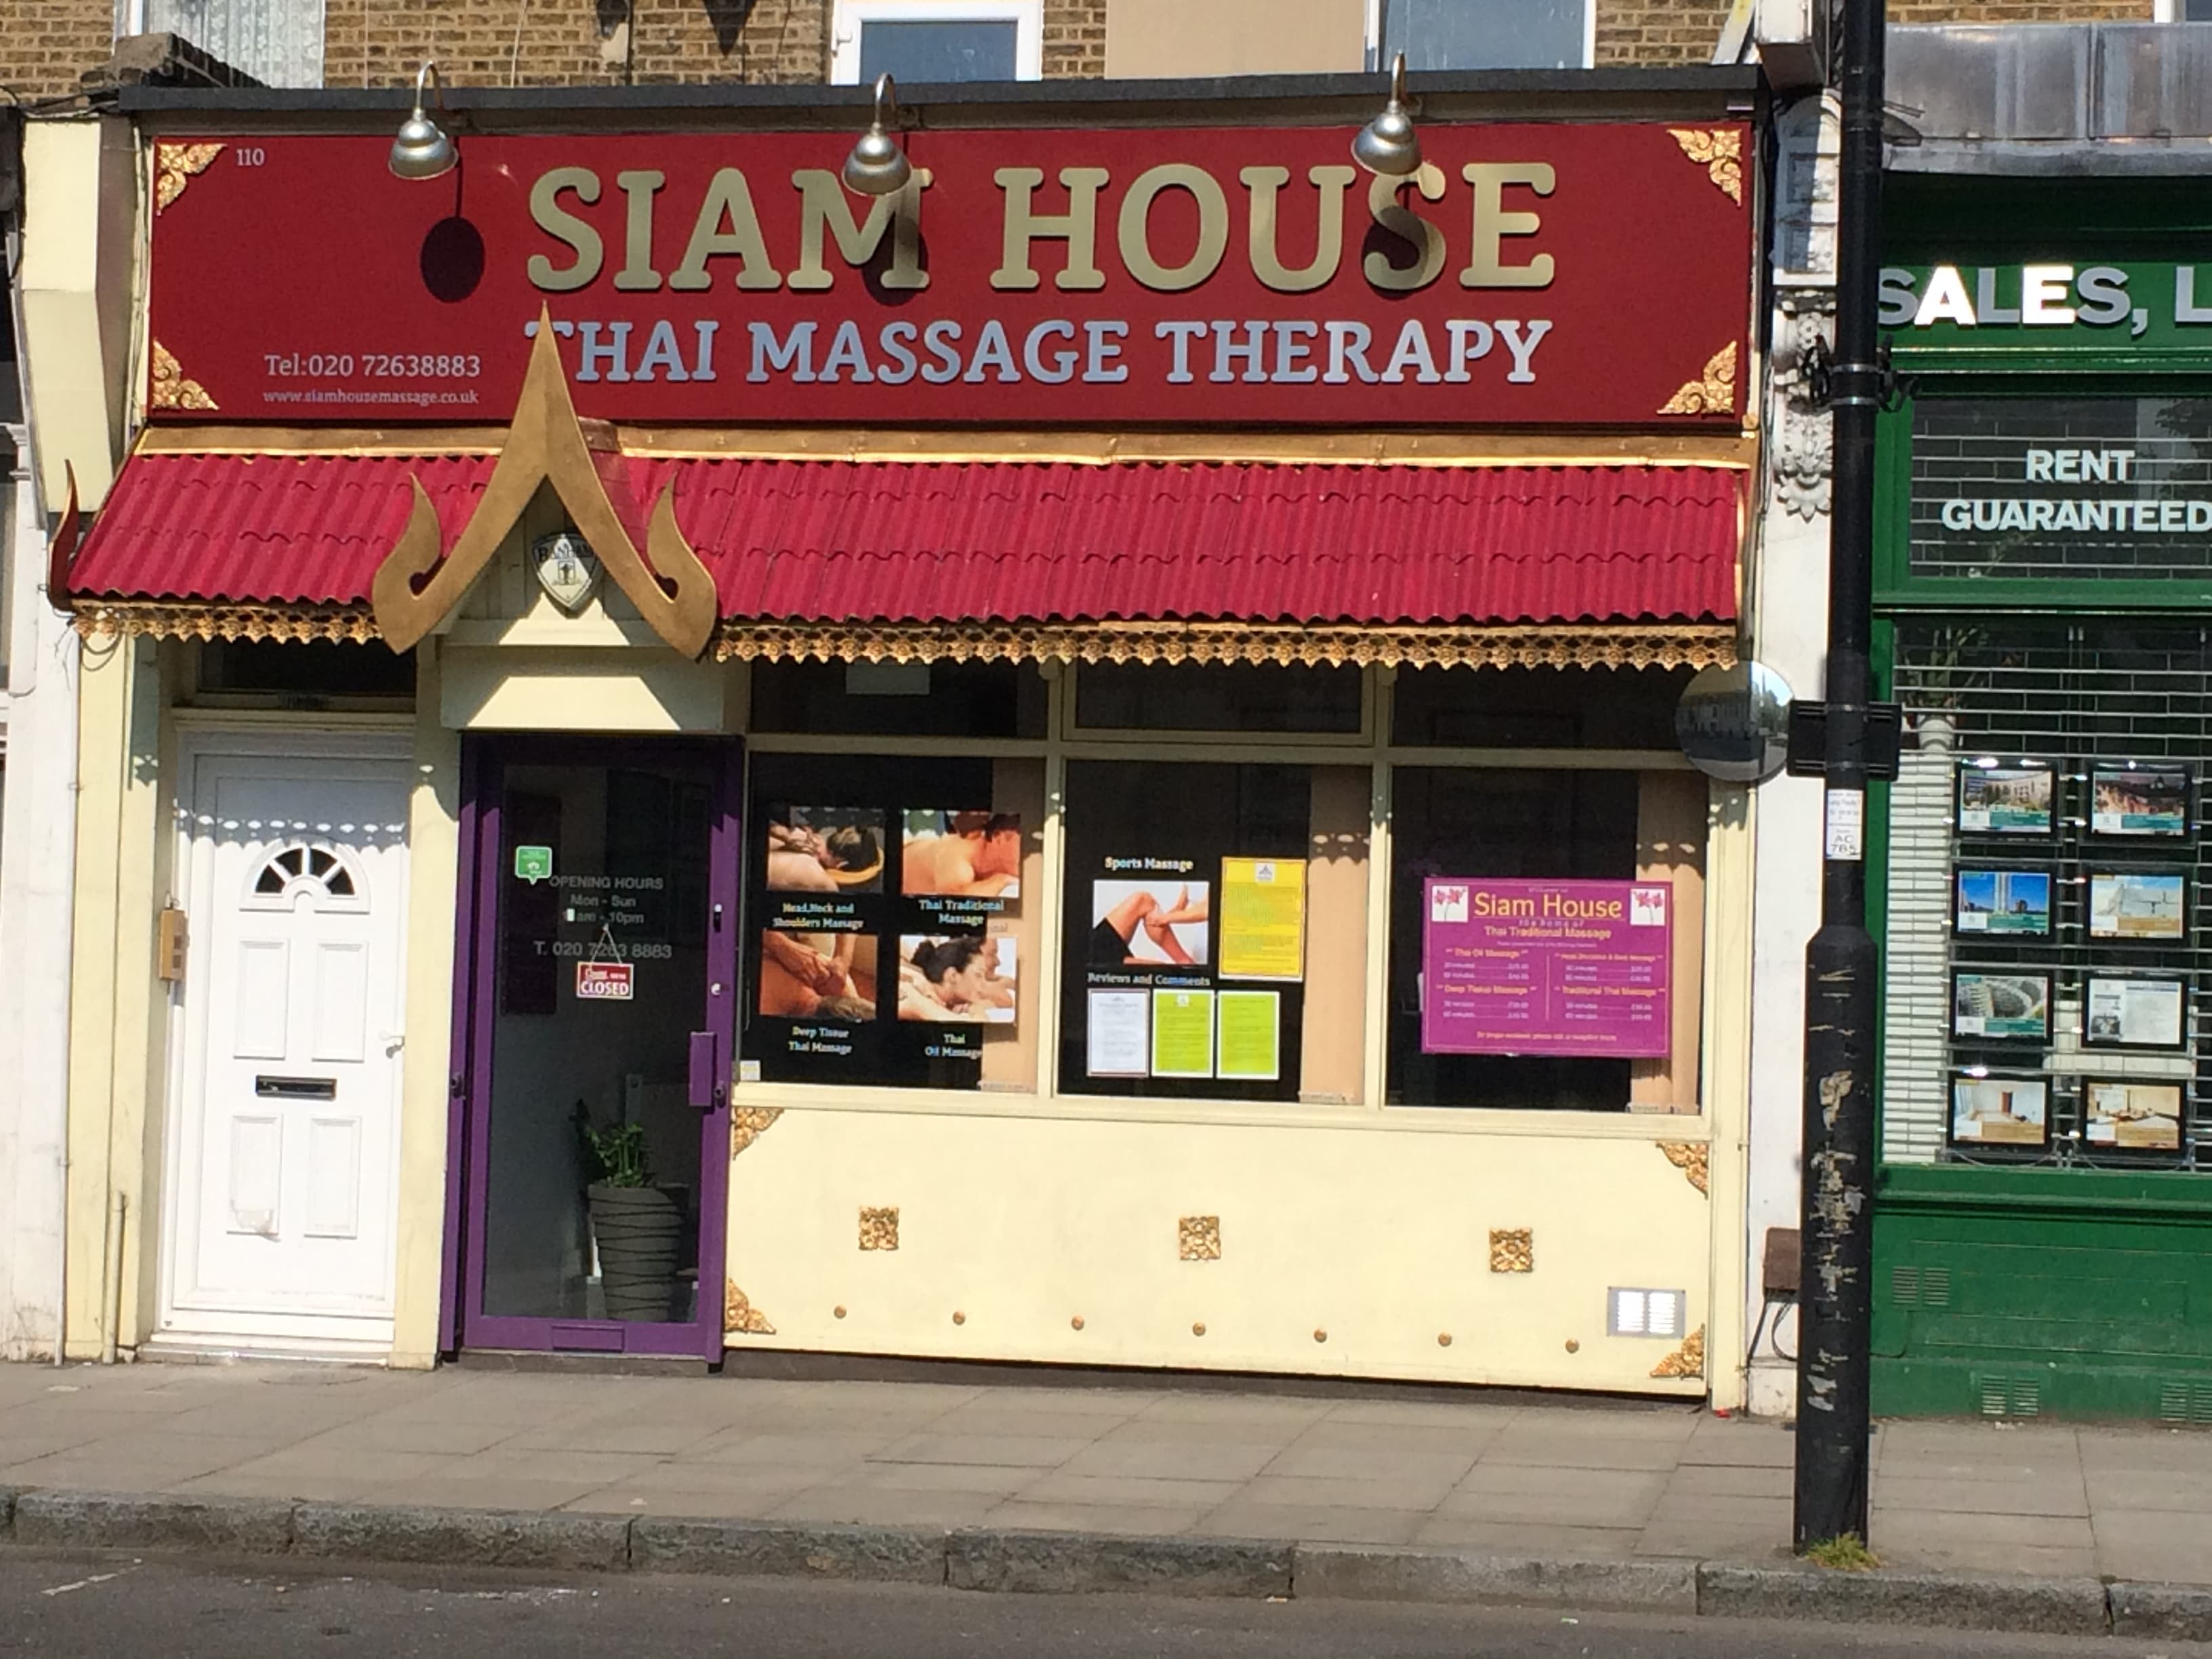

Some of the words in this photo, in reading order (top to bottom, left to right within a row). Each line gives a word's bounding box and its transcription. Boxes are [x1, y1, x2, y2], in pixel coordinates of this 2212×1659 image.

[236, 147, 265, 167] 110
[526, 165, 935, 291] SIAM
[989, 162, 1557, 293] HOUSE
[1878, 264, 2149, 335] SALES,
[746, 320, 1130, 384] MASSAGE
[1155, 319, 1553, 384] THERAPY
[264, 353, 354, 377] Tel:020
[361, 354, 481, 377] 72638883
[262, 388, 480, 407] www.siamhousemassage.co.uk
[2026, 449, 2135, 483] RENT
[1942, 499, 2212, 532] GUARANTEED
[1104, 856, 1142, 871] Sports
[1144, 857, 1193, 873] Massage
[549, 876, 611, 888] OPENING
[614, 877, 664, 890] HOURS
[570, 893, 599, 906] Mon
[611, 894, 636, 907] Sun
[918, 899, 943, 911] Thai
[945, 899, 1005, 911] Traditional
[1474, 892, 1534, 917] Siam
[1542, 893, 1623, 918] House
[938, 912, 985, 927] Massage
[552, 941, 583, 957] 020
[631, 943, 673, 959] 8883
[580, 980, 630, 996] CLOSED
[1088, 972, 1130, 984] Reviews
[1132, 973, 1152, 984] and
[1154, 975, 1210, 987] Comments
[788, 1041, 811, 1052] Thai
[943, 1033, 966, 1045] Thai
